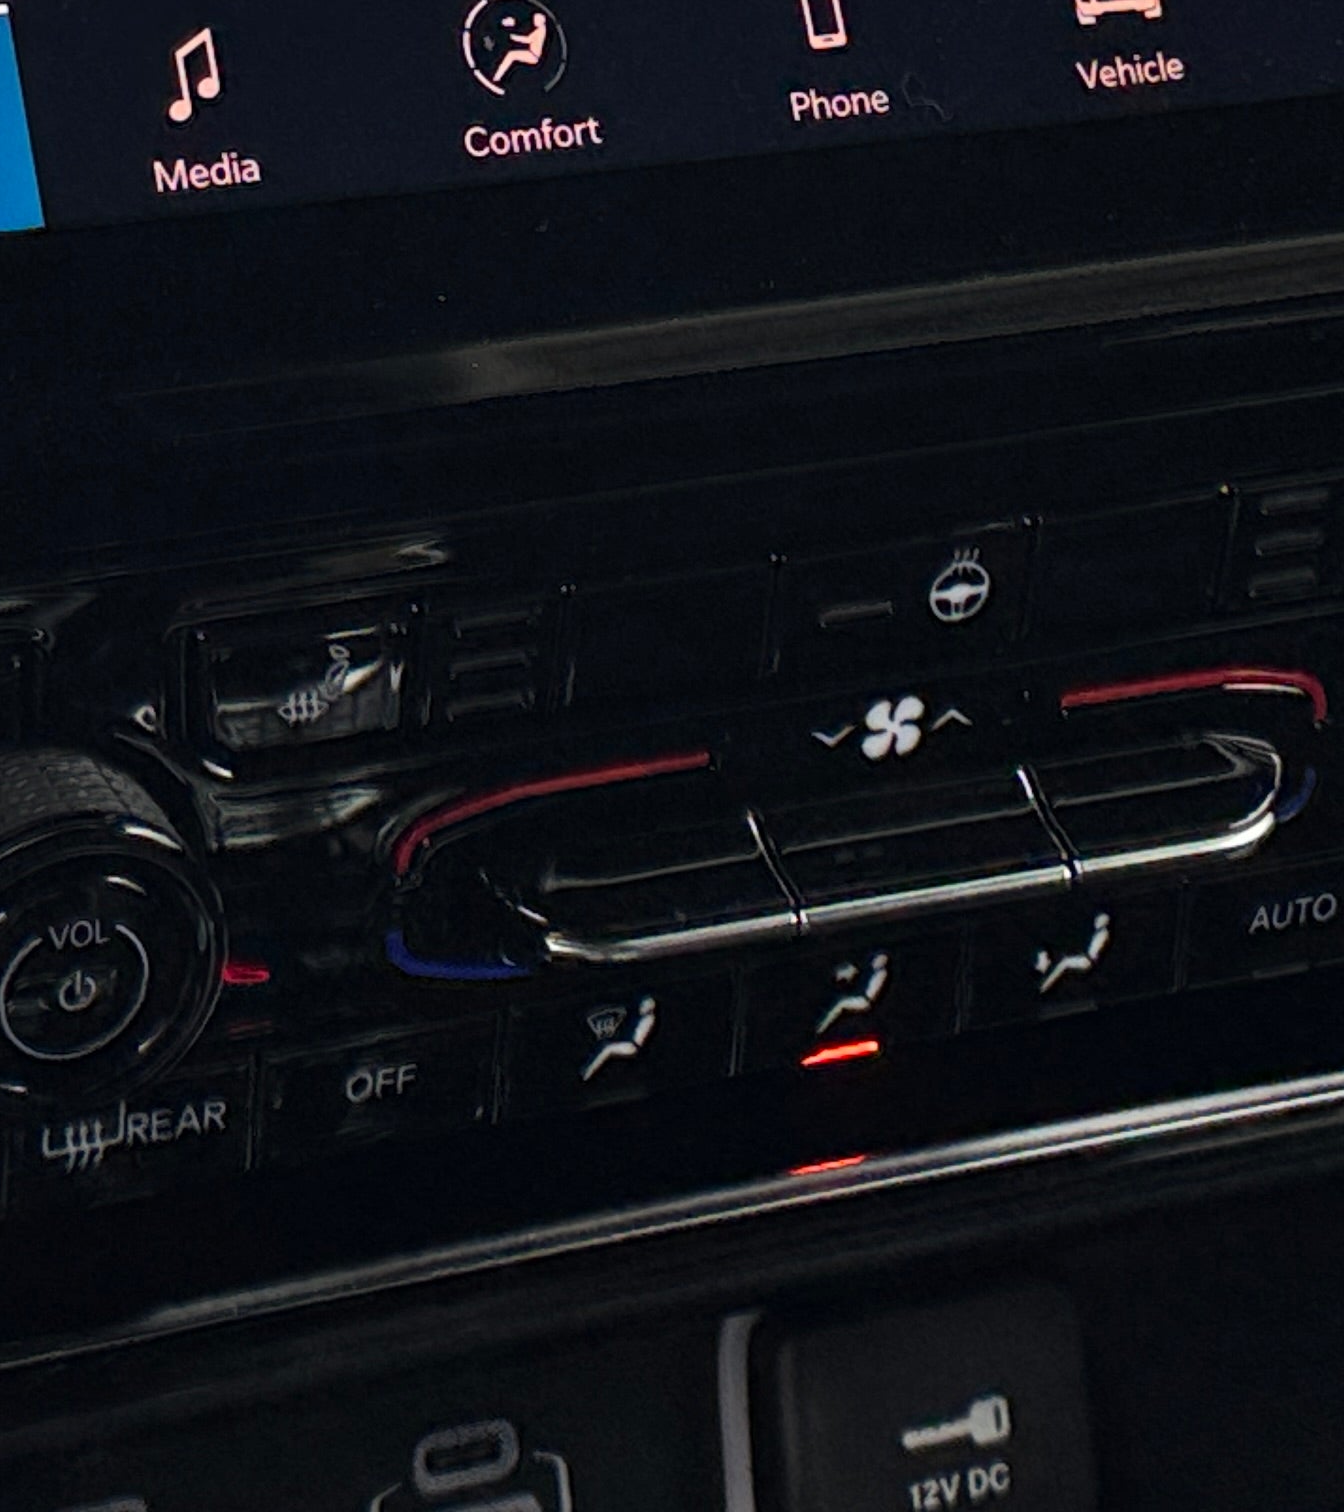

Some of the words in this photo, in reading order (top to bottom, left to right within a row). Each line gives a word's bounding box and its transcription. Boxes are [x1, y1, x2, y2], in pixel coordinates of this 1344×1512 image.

[1076, 53, 1185, 91] Vehicle
[789, 88, 892, 122] Phone
[464, 117, 604, 159] Comfort
[153, 154, 262, 192] Media
[1248, 894, 1338, 934] AUTO
[47, 920, 109, 951] VOL
[345, 1064, 418, 1103] OFF
[125, 1099, 227, 1144] REAR
[910, 1472, 961, 1511] 12V
[967, 1463, 1011, 1502] DC
